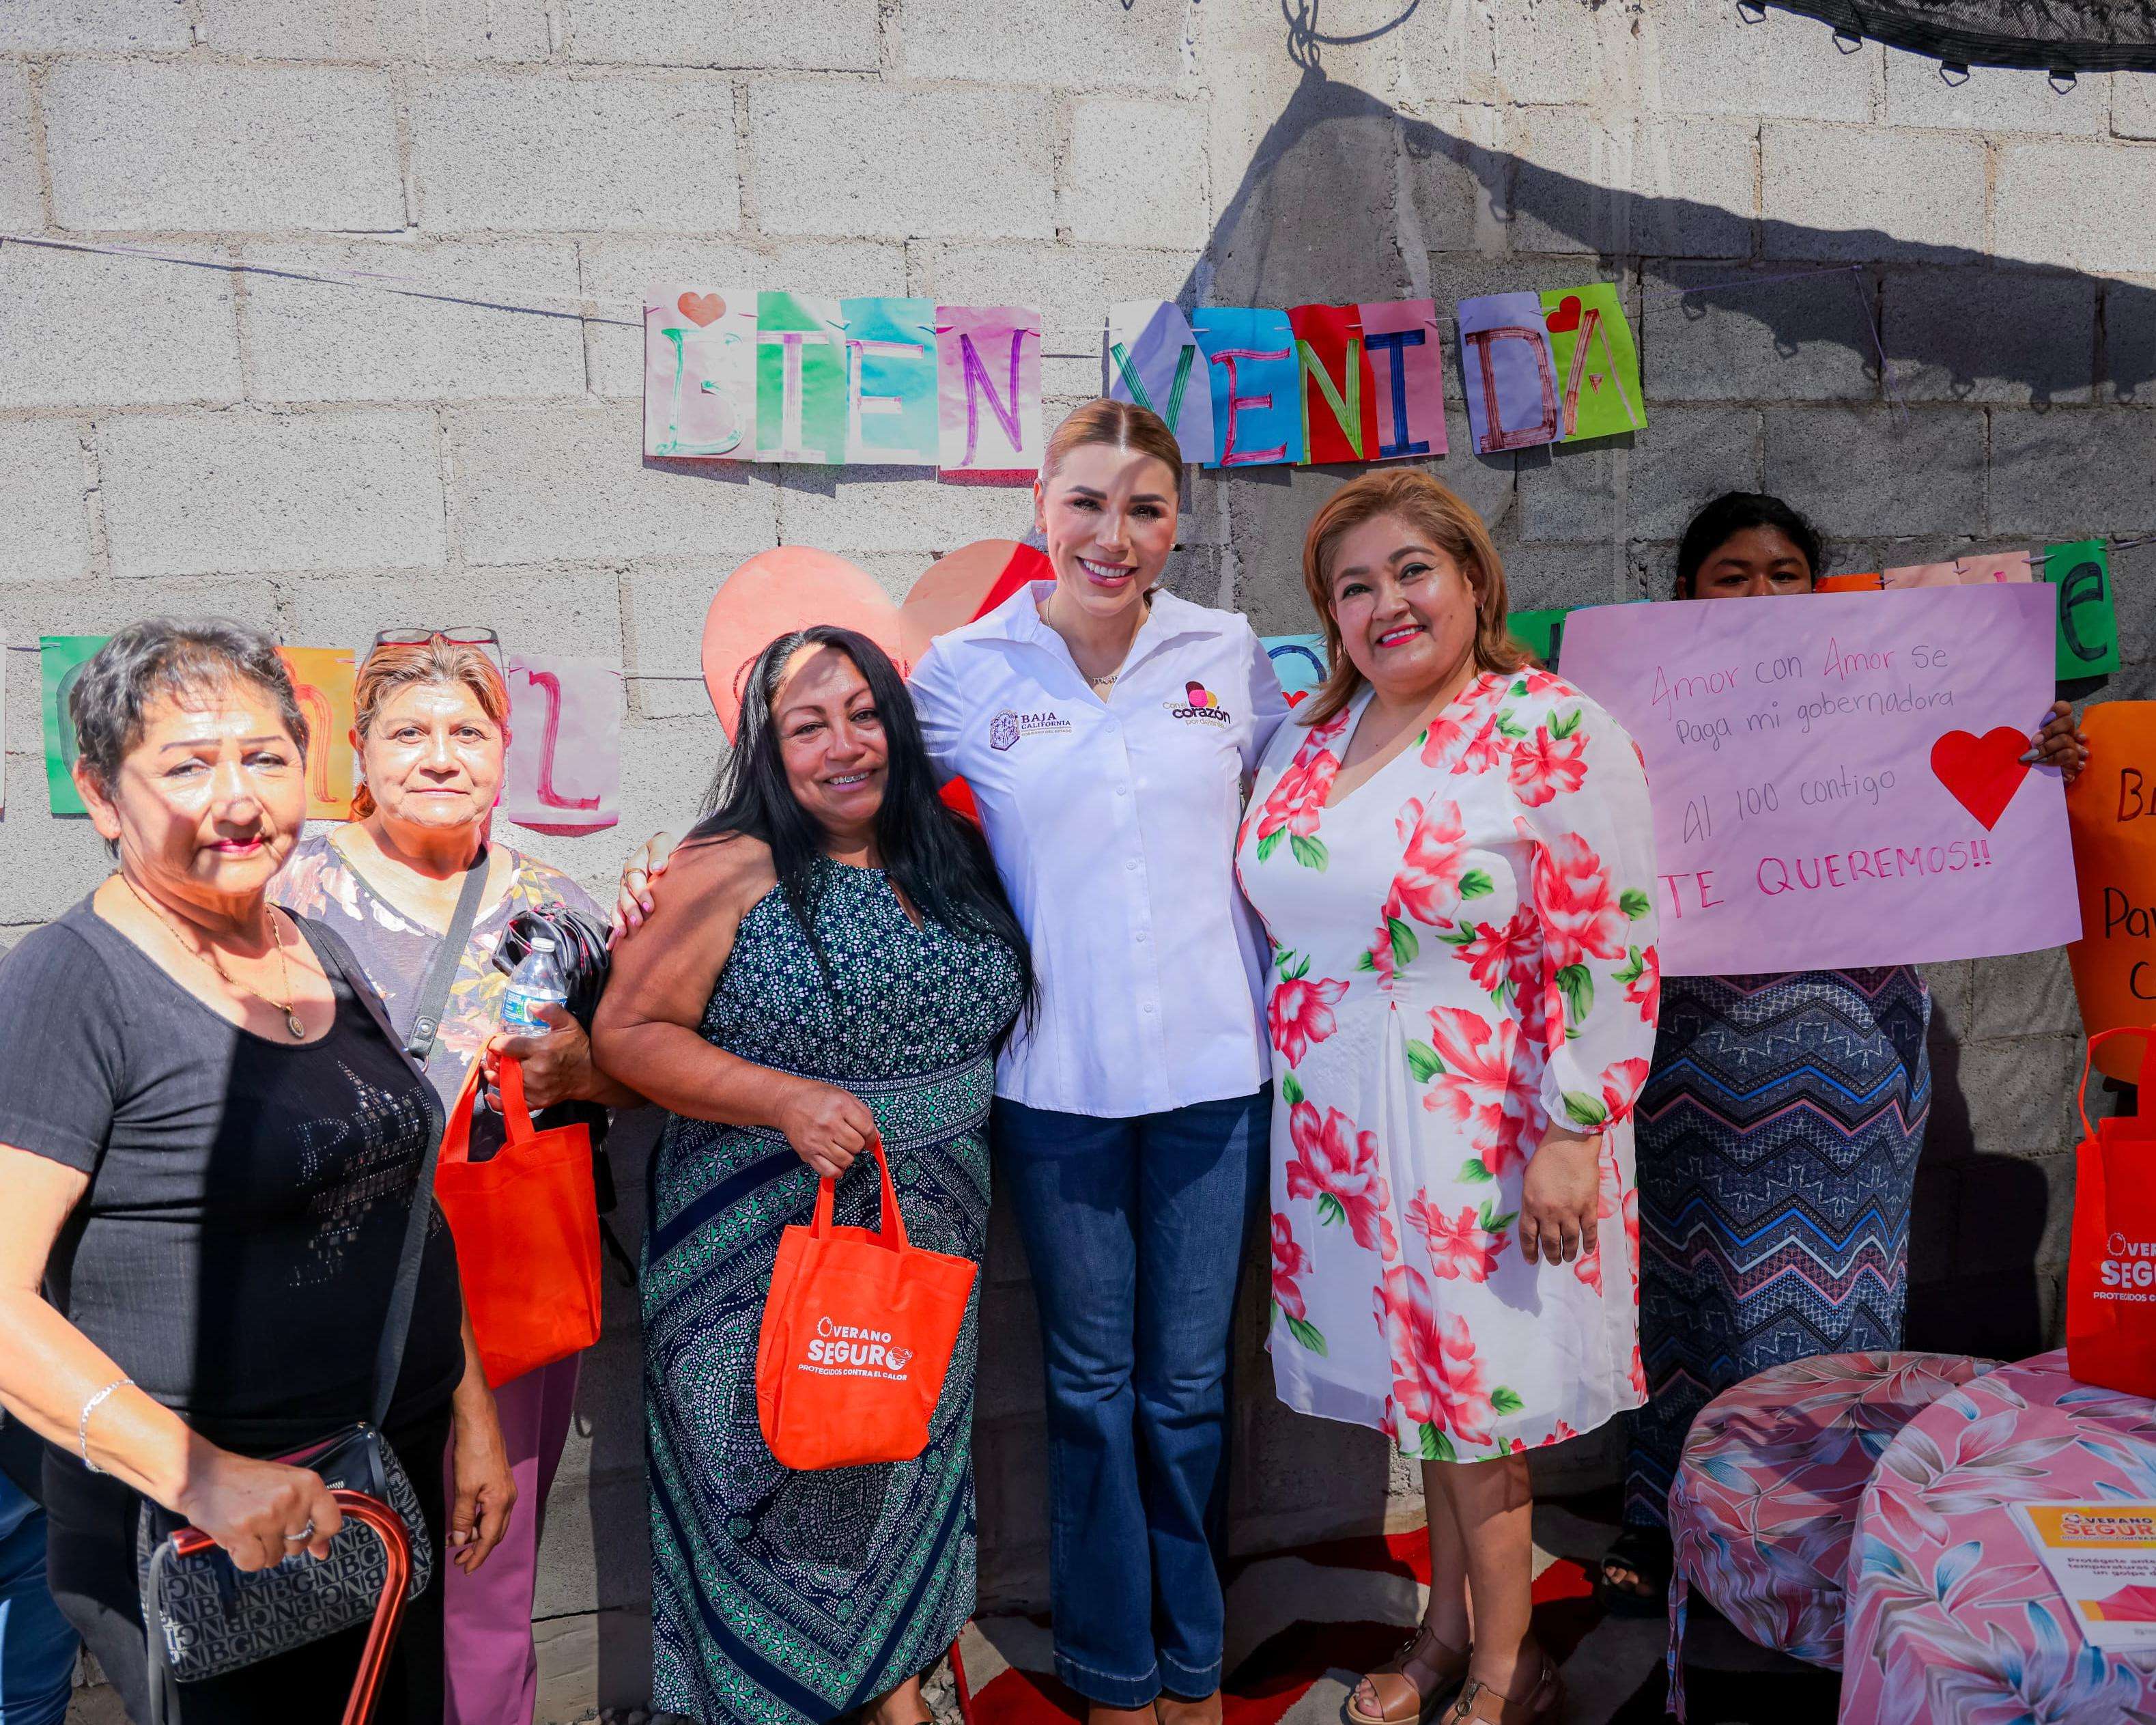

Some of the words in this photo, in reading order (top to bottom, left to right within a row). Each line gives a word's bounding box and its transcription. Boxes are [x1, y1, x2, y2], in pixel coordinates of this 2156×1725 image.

[1651, 665, 1739, 721] Amor
[1755, 655, 1802, 684] con
[1824, 636, 1895, 682] Amor
[1020, 712, 1058, 724] BAJA
[1172, 705, 1231, 725] corazón
[1746, 701, 1781, 732] mi
[1796, 682, 1954, 734] gobernadora
[1021, 720, 1071, 730] CALIFORNIA
[1736, 782, 1779, 821] 100
[1800, 763, 1896, 806] contigo
[1657, 871, 1725, 918] TE
[1755, 839, 1993, 896] QUEREMOS!!
[832, 1326, 892, 1344] VERANO
[797, 1363, 842, 1375] PROTEGIDOS
[842, 1369, 874, 1377] CONTRA
[882, 1373, 907, 1382] CALOR
